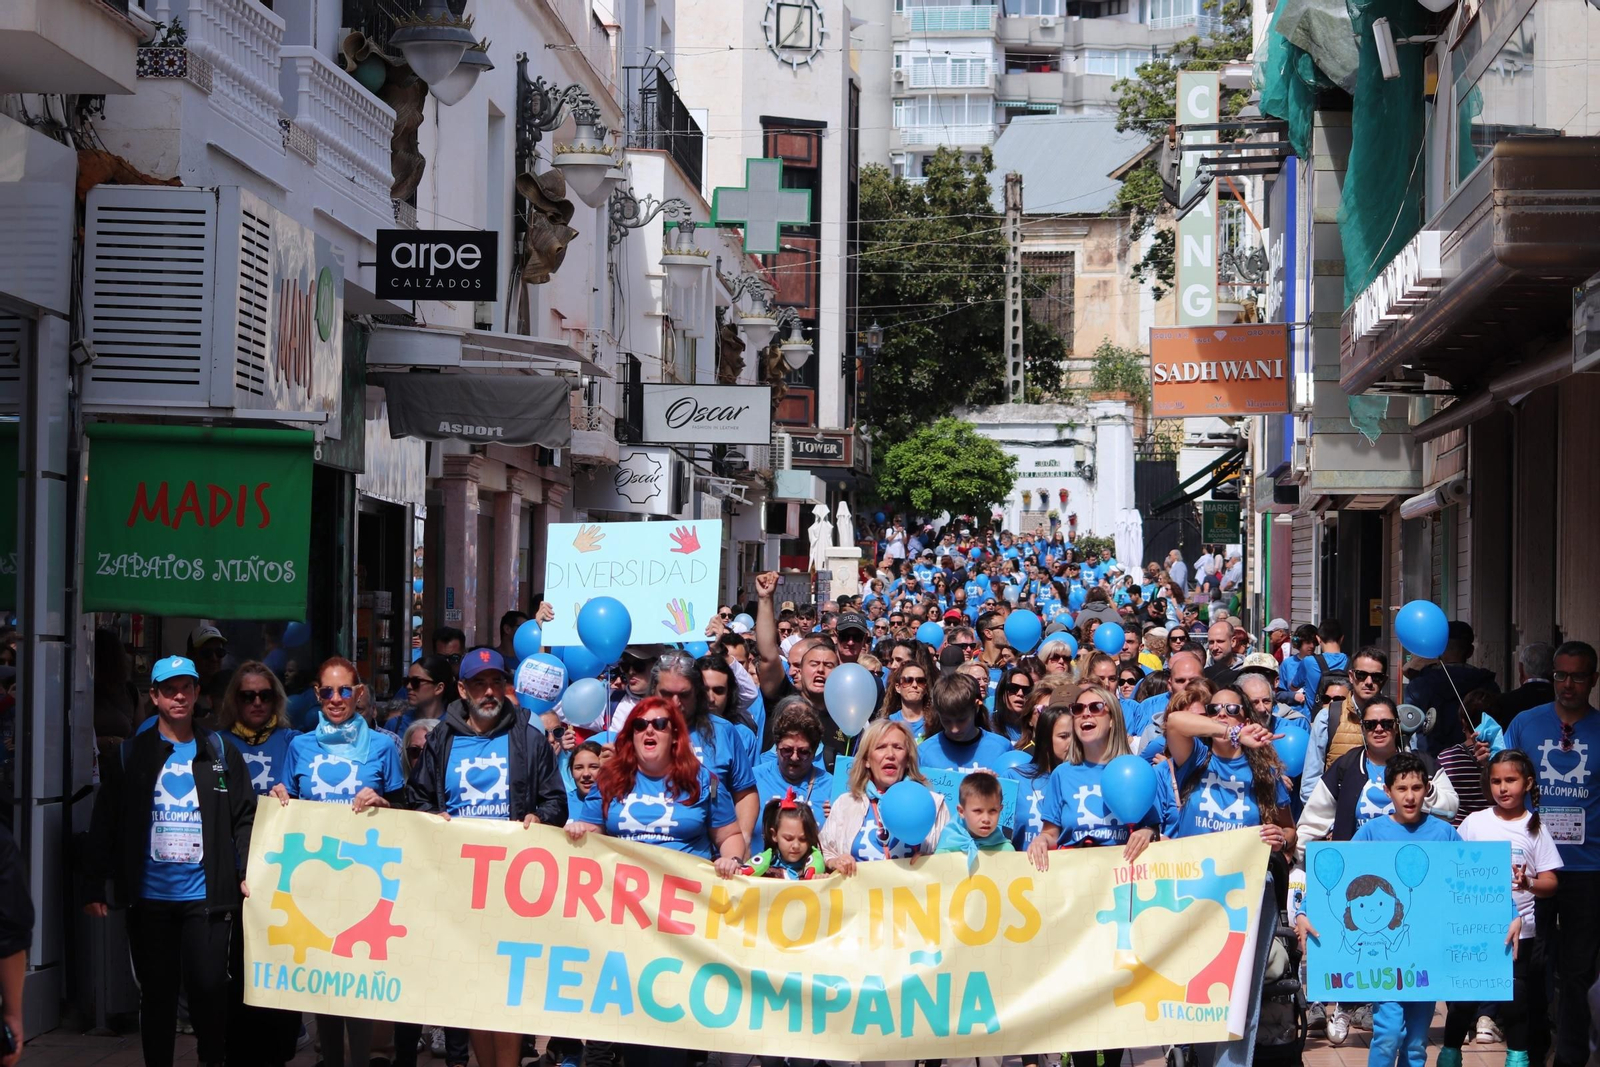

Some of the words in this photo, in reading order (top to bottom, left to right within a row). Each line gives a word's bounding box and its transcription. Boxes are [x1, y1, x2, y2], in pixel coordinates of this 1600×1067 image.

[391, 242, 482, 276] arpe
[391, 277, 482, 289] CALZADOS
[1154, 360, 1284, 383] SADHWANI
[665, 396, 750, 429] Oscar
[438, 421, 504, 437] Asport
[797, 441, 838, 454] TOWER
[614, 467, 664, 488] Oscar
[126, 480, 271, 530] MADIS
[1204, 503, 1239, 512] MARKET
[96, 552, 205, 581] ZAPATOS
[212, 555, 296, 583] NIÑOS
[547, 559, 708, 590] DIVERSIDAD
[1537, 784, 1589, 799] EACOMPAÑO
[1113, 861, 1200, 885] TORREMOLINOS
[460, 843, 1041, 954] TORREMOLINOS
[252, 961, 402, 1003] TEACOMPAÑO
[497, 940, 1001, 1039] TEACOMPAÑA
[1324, 962, 1430, 991] INCLUSIÓN
